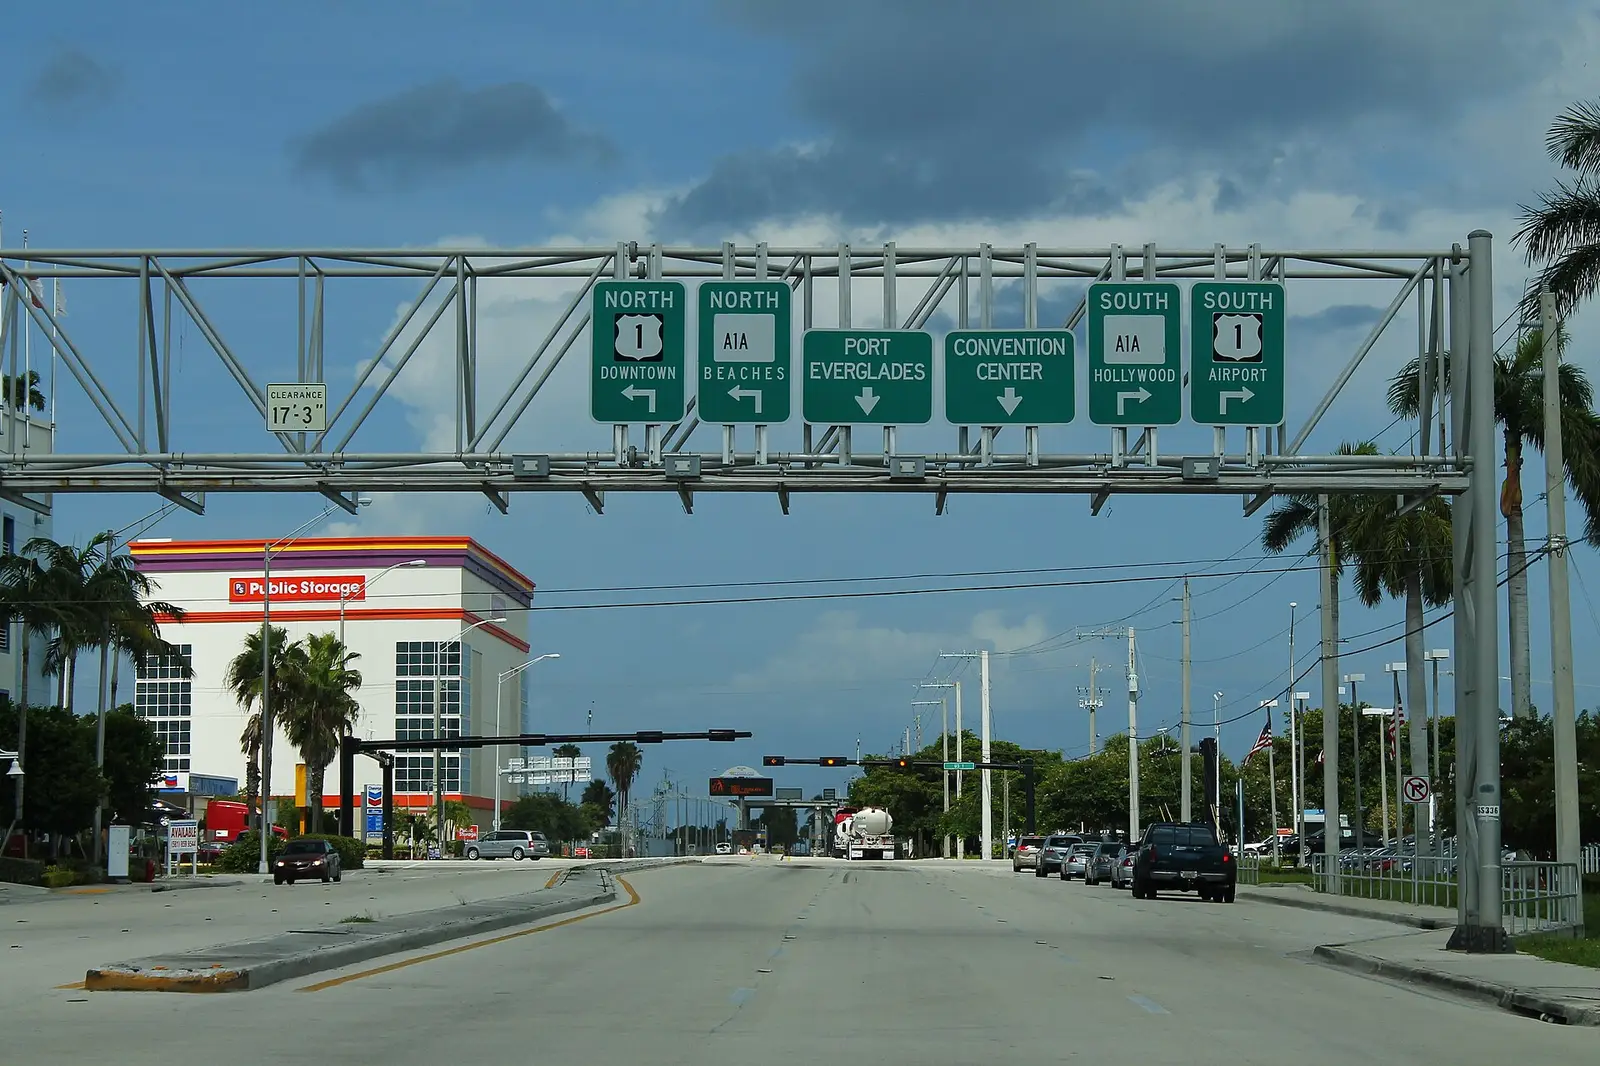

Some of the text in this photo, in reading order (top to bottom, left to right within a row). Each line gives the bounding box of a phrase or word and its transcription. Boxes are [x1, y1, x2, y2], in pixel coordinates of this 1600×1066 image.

[605, 290, 674, 308] NORTH
[710, 291, 779, 309] NORTH
[1100, 292, 1169, 310] SOUTH
[1203, 291, 1273, 309] SOUTH
[635, 323, 643, 350] 1
[723, 332, 748, 350] A1A
[1115, 334, 1140, 352] A1A
[1234, 324, 1242, 350] 1
[844, 338, 890, 356] PORT
[954, 338, 1066, 356] CONVENTION
[600, 366, 677, 380] DOWNTOWN
[704, 366, 785, 380] BEACHES
[810, 362, 926, 380] EVERGLADES
[976, 362, 1042, 381] CENTER
[1094, 368, 1176, 383] HOLLYWOOD
[1208, 368, 1268, 382] AIRPORT
[270, 391, 322, 399] CLEARANCE
[272, 404, 323, 424] 17'-3"
[249, 581, 360, 597] Public Storage
[171, 827, 196, 838] AVAILABLE
